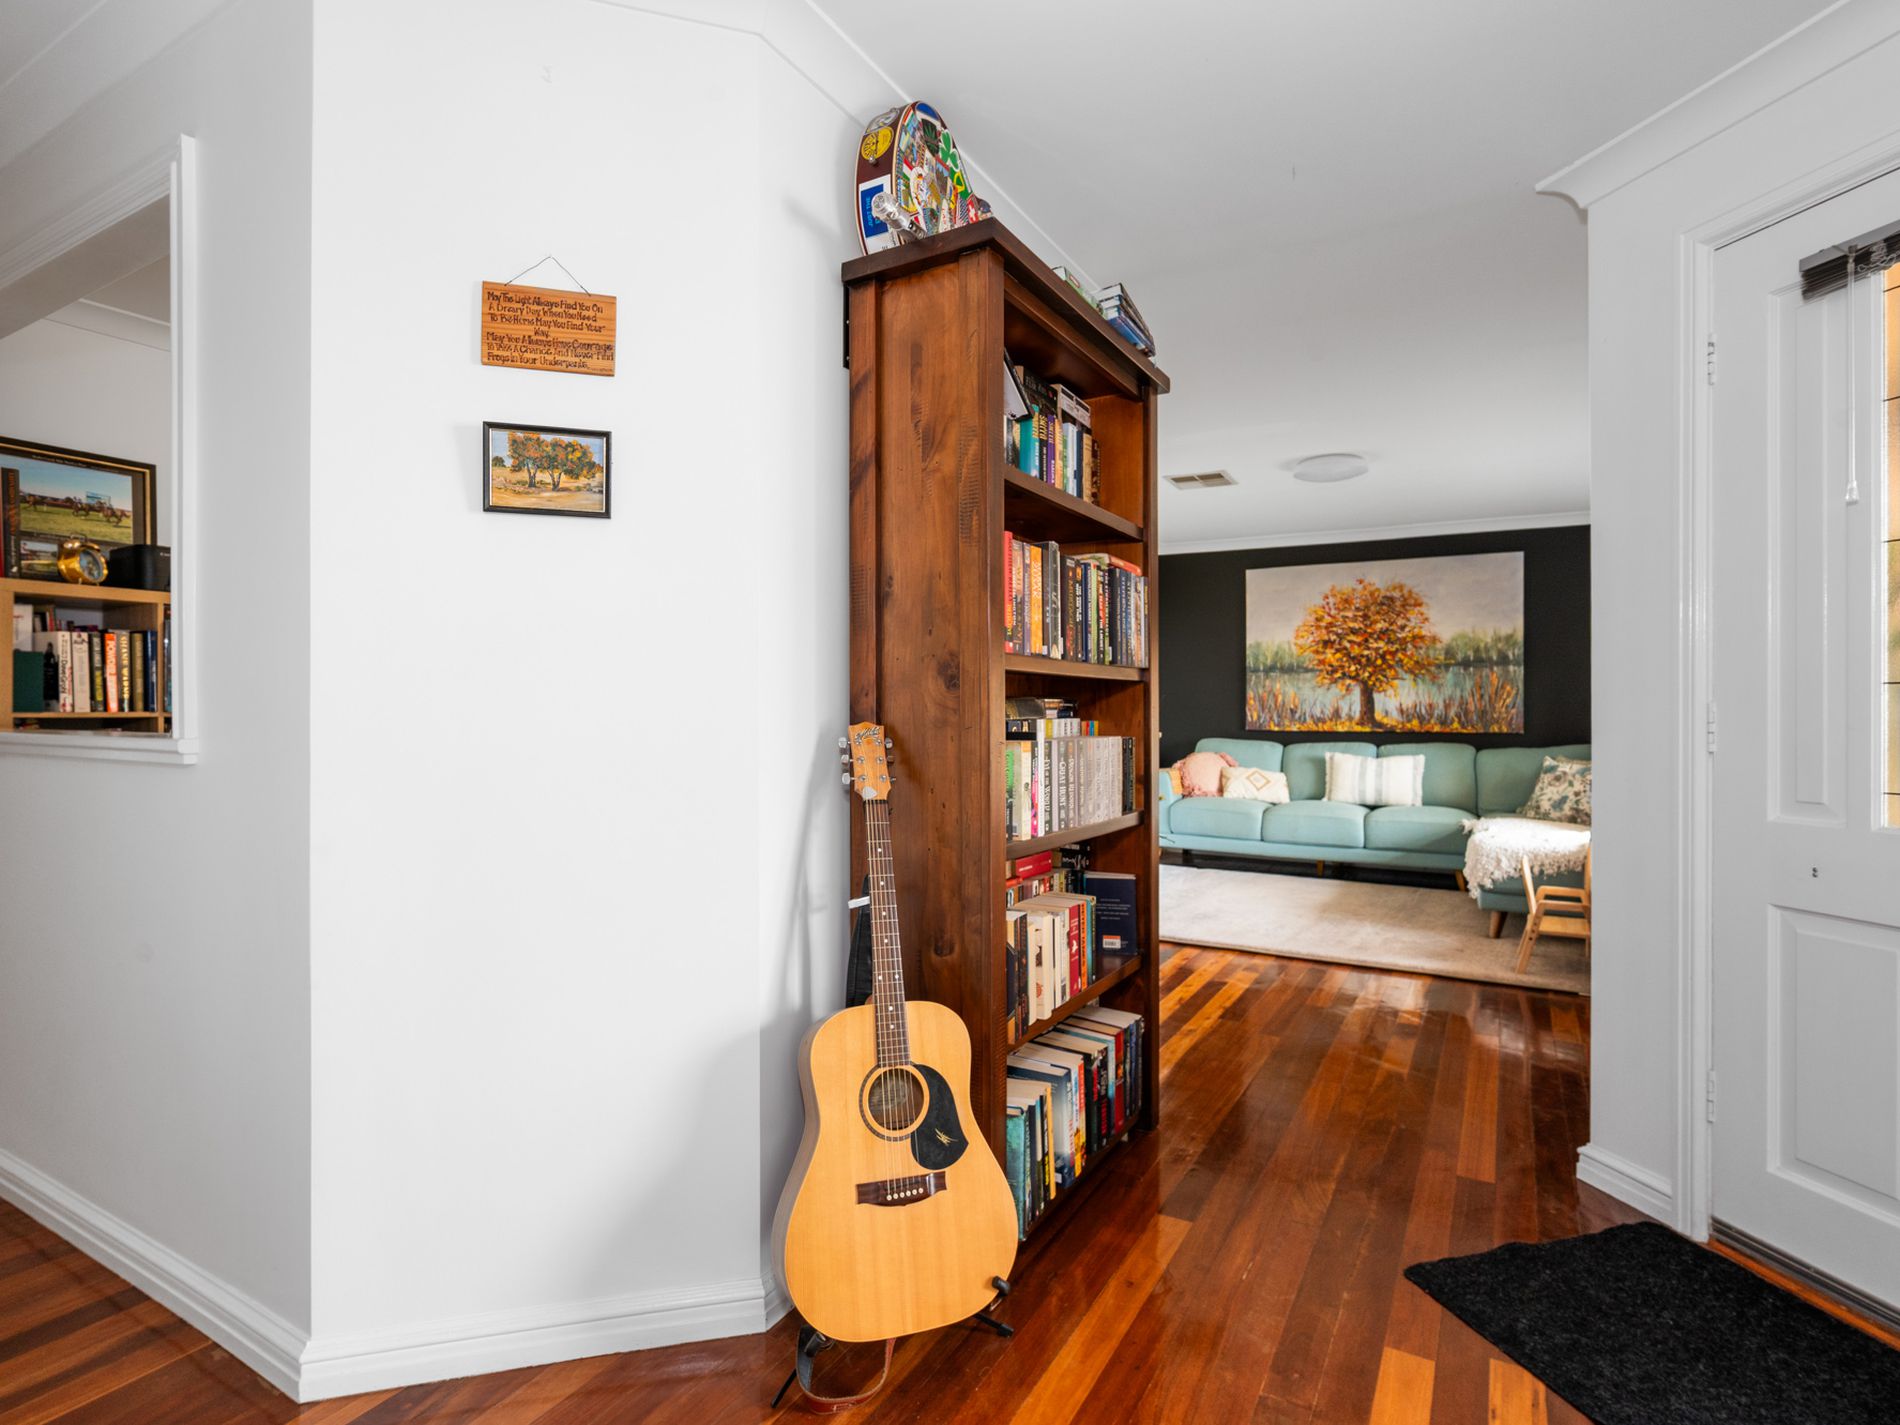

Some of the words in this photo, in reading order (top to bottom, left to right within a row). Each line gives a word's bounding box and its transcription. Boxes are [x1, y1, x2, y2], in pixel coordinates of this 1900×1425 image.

[487, 292, 501, 302] May
[515, 294, 531, 306] Light
[532, 297, 560, 310] Always
[560, 300, 577, 311] Find
[578, 302, 590, 311] You
[592, 304, 603, 313] On
[497, 305, 524, 316] Dreary
[526, 306, 541, 316] Day
[564, 310, 577, 320] You
[577, 311, 597, 322] Need
[536, 318, 551, 328] May
[552, 319, 566, 329] You
[567, 320, 583, 331] Find
[585, 322, 605, 333] Your
[486, 332, 506, 344] May
[518, 354, 538, 365] Your
[120, 636, 129, 666] SHANE
[121, 667, 130, 699] WARNE
